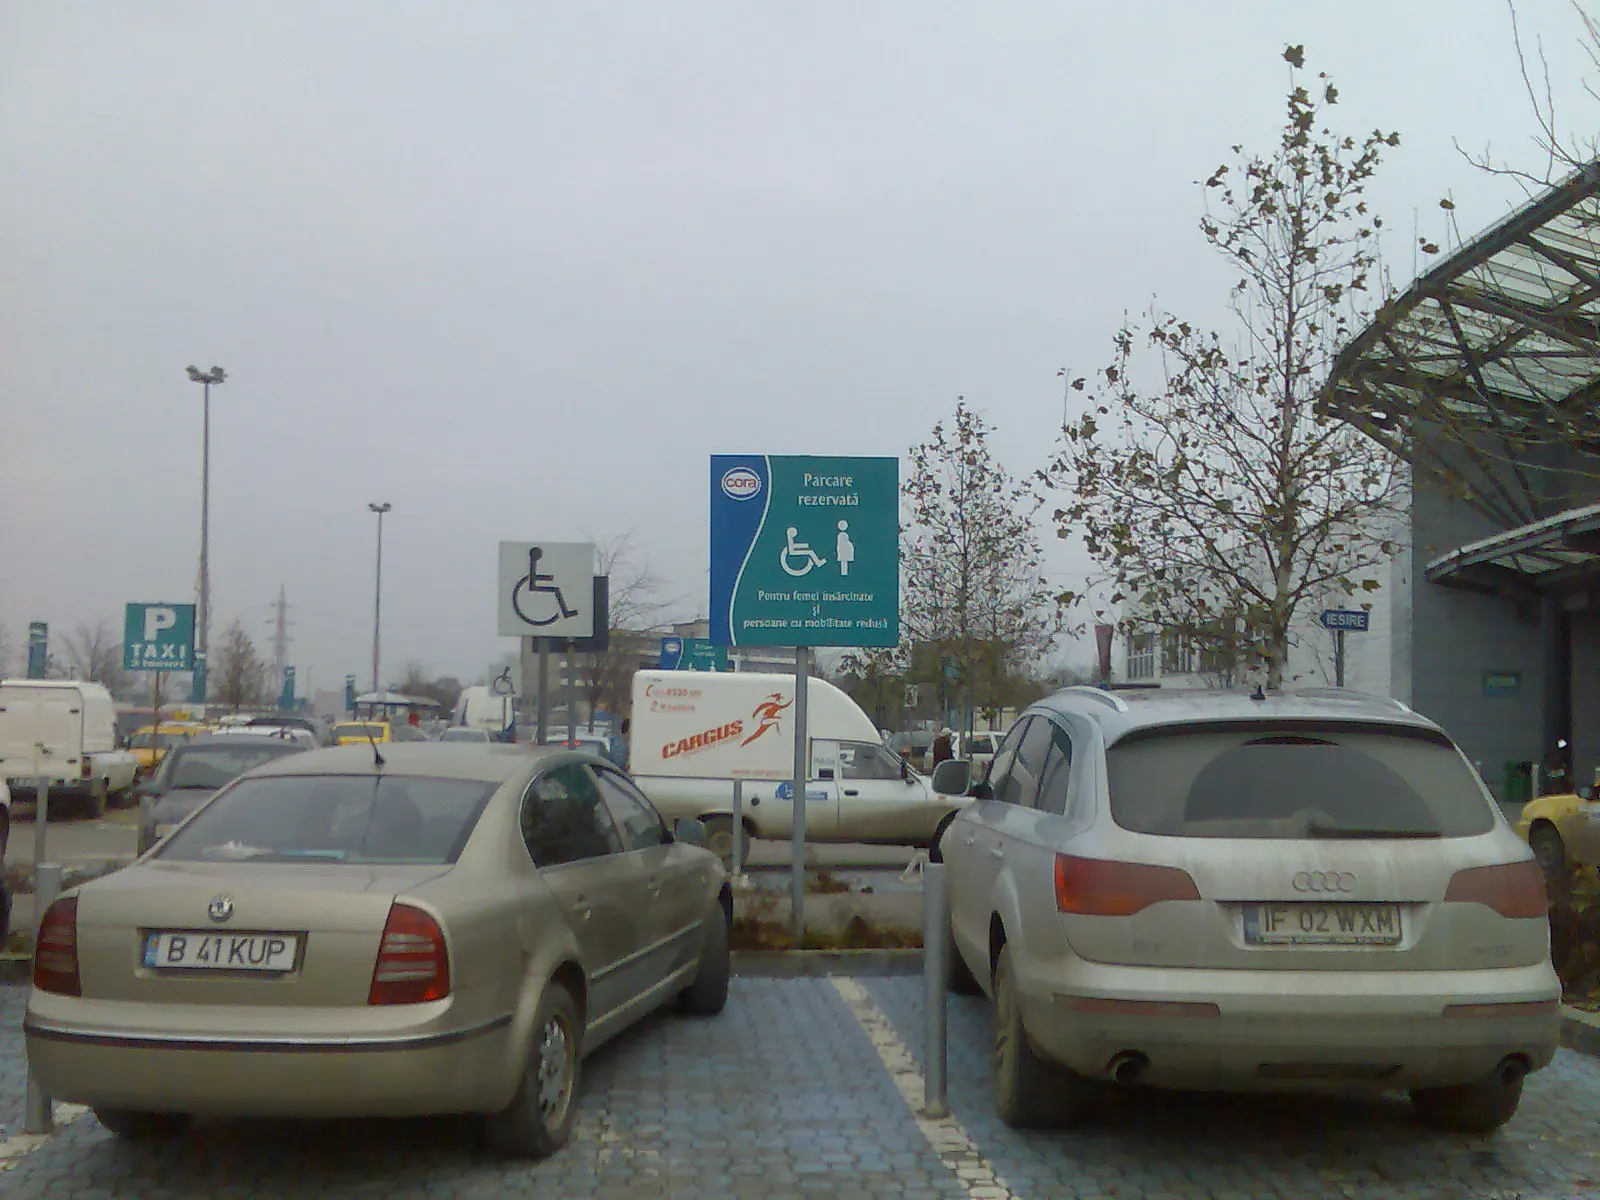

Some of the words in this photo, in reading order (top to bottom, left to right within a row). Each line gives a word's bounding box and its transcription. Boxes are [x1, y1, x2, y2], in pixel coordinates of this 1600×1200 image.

[726, 477, 757, 489] cora
[804, 472, 853, 487] Parcare
[798, 492, 859, 506] rezervată
[758, 590, 791, 601] Pentru
[793, 589, 819, 601] femei
[144, 607, 176, 641] P
[743, 618, 787, 629] persoane
[791, 619, 802, 628] cu
[805, 617, 853, 628] mobilitate
[131, 643, 186, 659] TAXI
[662, 719, 743, 759] CARGUS
[1265, 907, 1288, 932] IF
[1300, 908, 1330, 933] 02
[1336, 906, 1394, 934] WXM
[167, 936, 188, 962] B
[197, 937, 222, 963] 41
[228, 938, 285, 965] KUP
